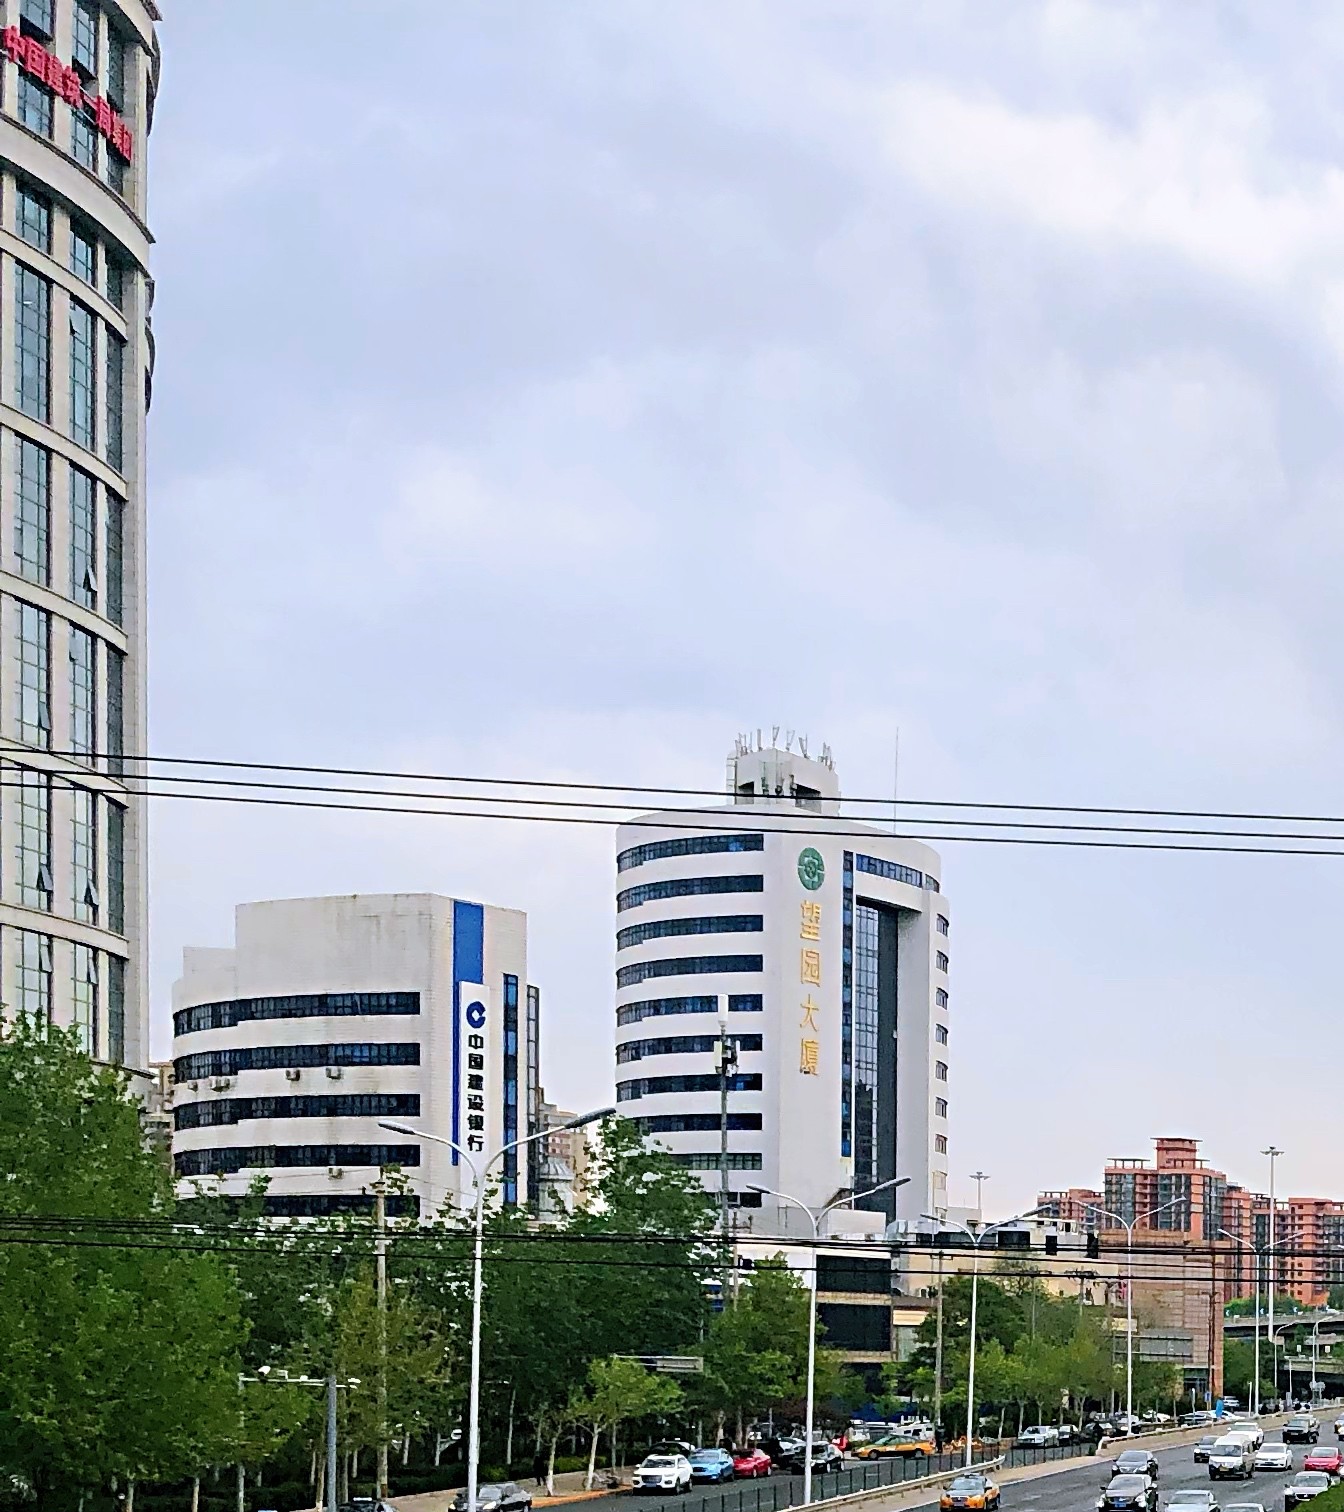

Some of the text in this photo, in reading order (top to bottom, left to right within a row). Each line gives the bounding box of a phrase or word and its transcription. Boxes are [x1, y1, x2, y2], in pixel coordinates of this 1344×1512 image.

[800, 900, 822, 1077] 望园大厦
[467, 1034, 485, 1152] 中国建设银行
